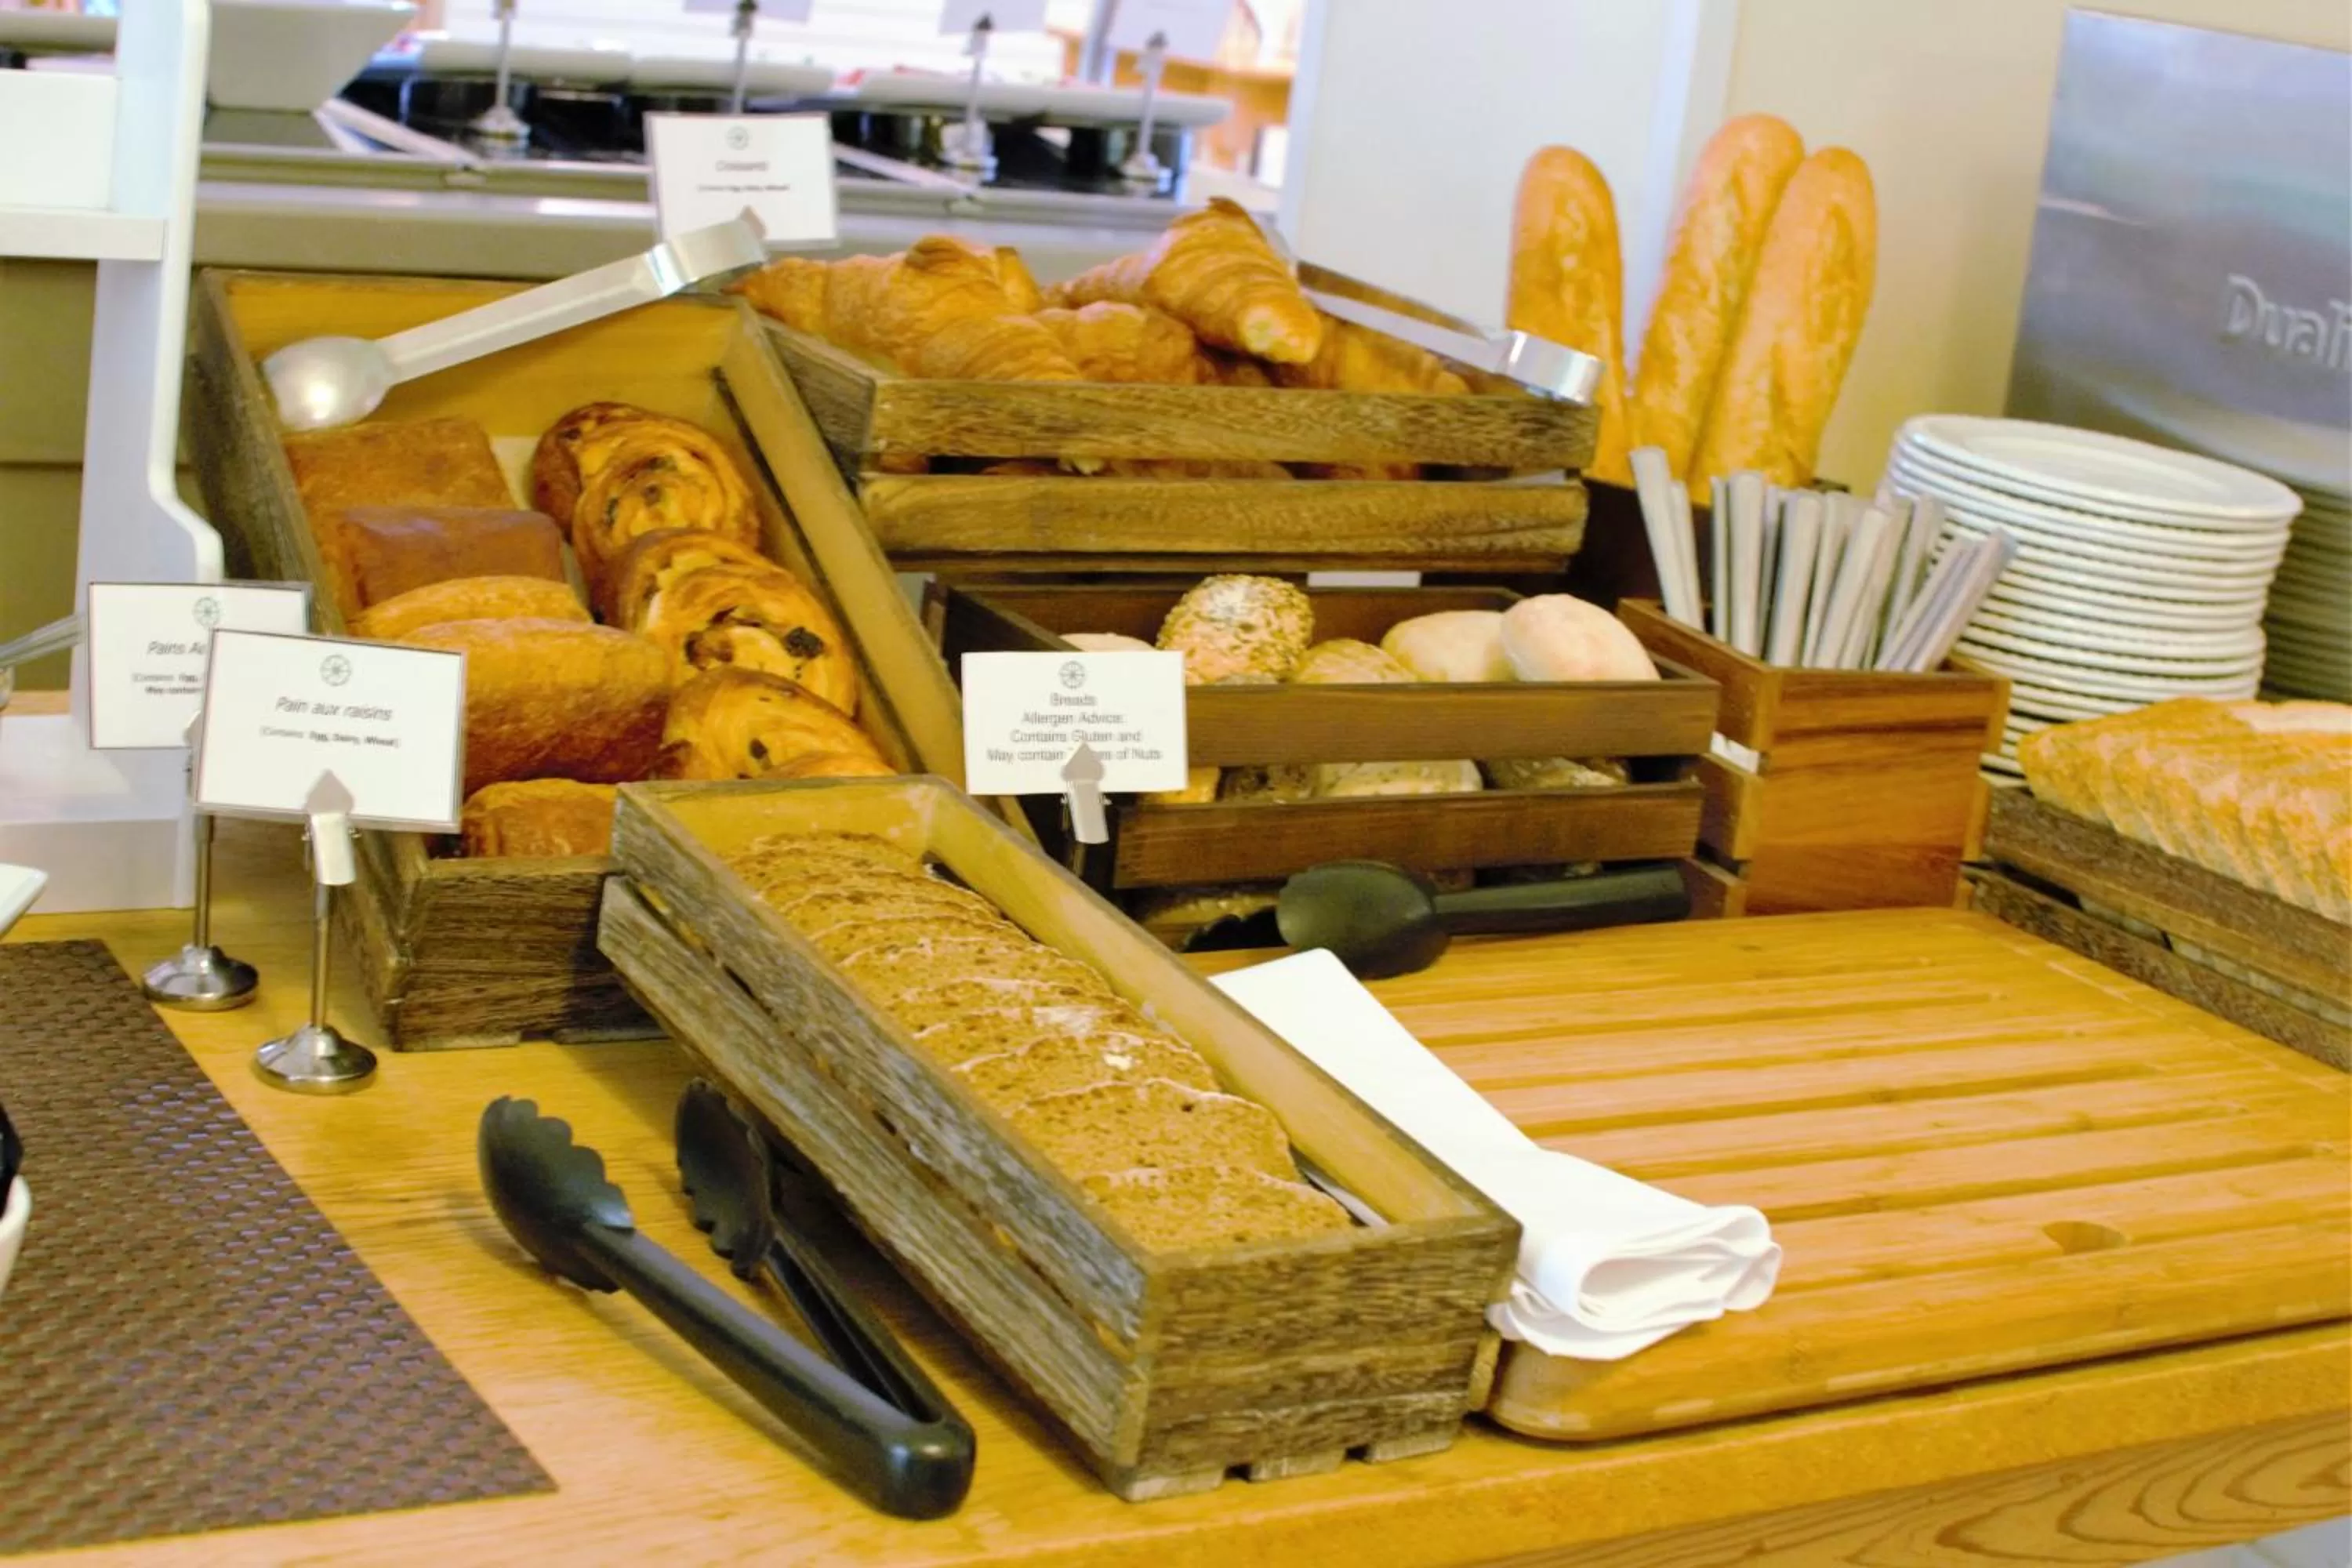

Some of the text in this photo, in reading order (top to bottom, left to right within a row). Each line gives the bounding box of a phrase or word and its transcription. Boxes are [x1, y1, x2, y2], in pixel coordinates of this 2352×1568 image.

[1050, 692, 1097, 706] Breads
[275, 695, 394, 721] Pain aux raisins
[1022, 711, 1073, 728] Allergen
[1010, 729, 1142, 742] Contains Gluten and
[986, 748, 1013, 763] May
[1018, 748, 1065, 760] contain
[1116, 746, 1130, 760] of
[1131, 747, 1163, 760] Nuts
